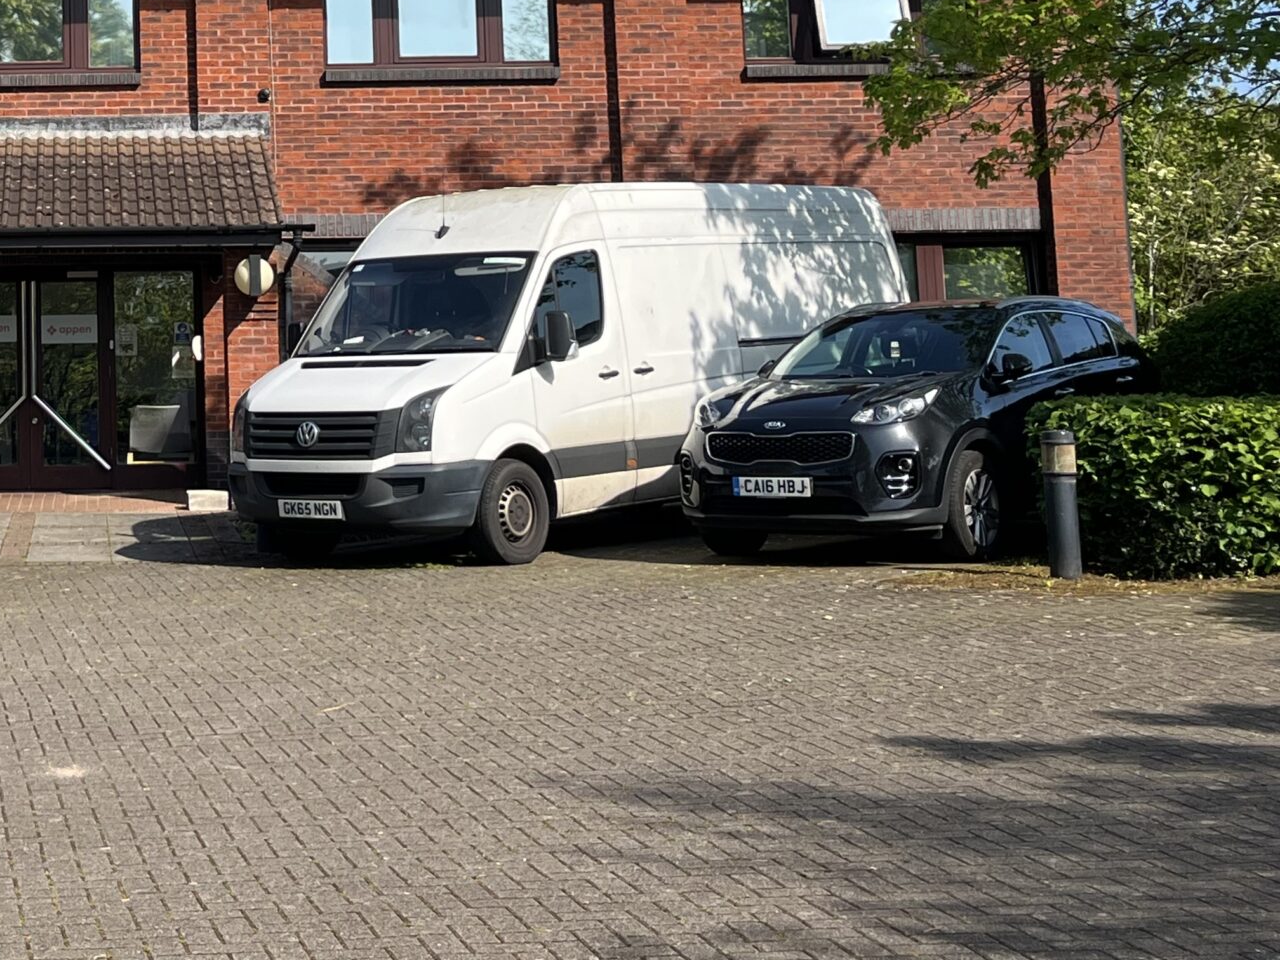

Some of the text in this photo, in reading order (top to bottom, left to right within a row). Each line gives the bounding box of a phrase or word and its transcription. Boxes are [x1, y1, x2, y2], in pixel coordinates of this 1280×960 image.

[59, 325, 92, 336] appen
[743, 478, 806, 494] CA16 HBJ
[283, 501, 337, 516] GK65 NGN
